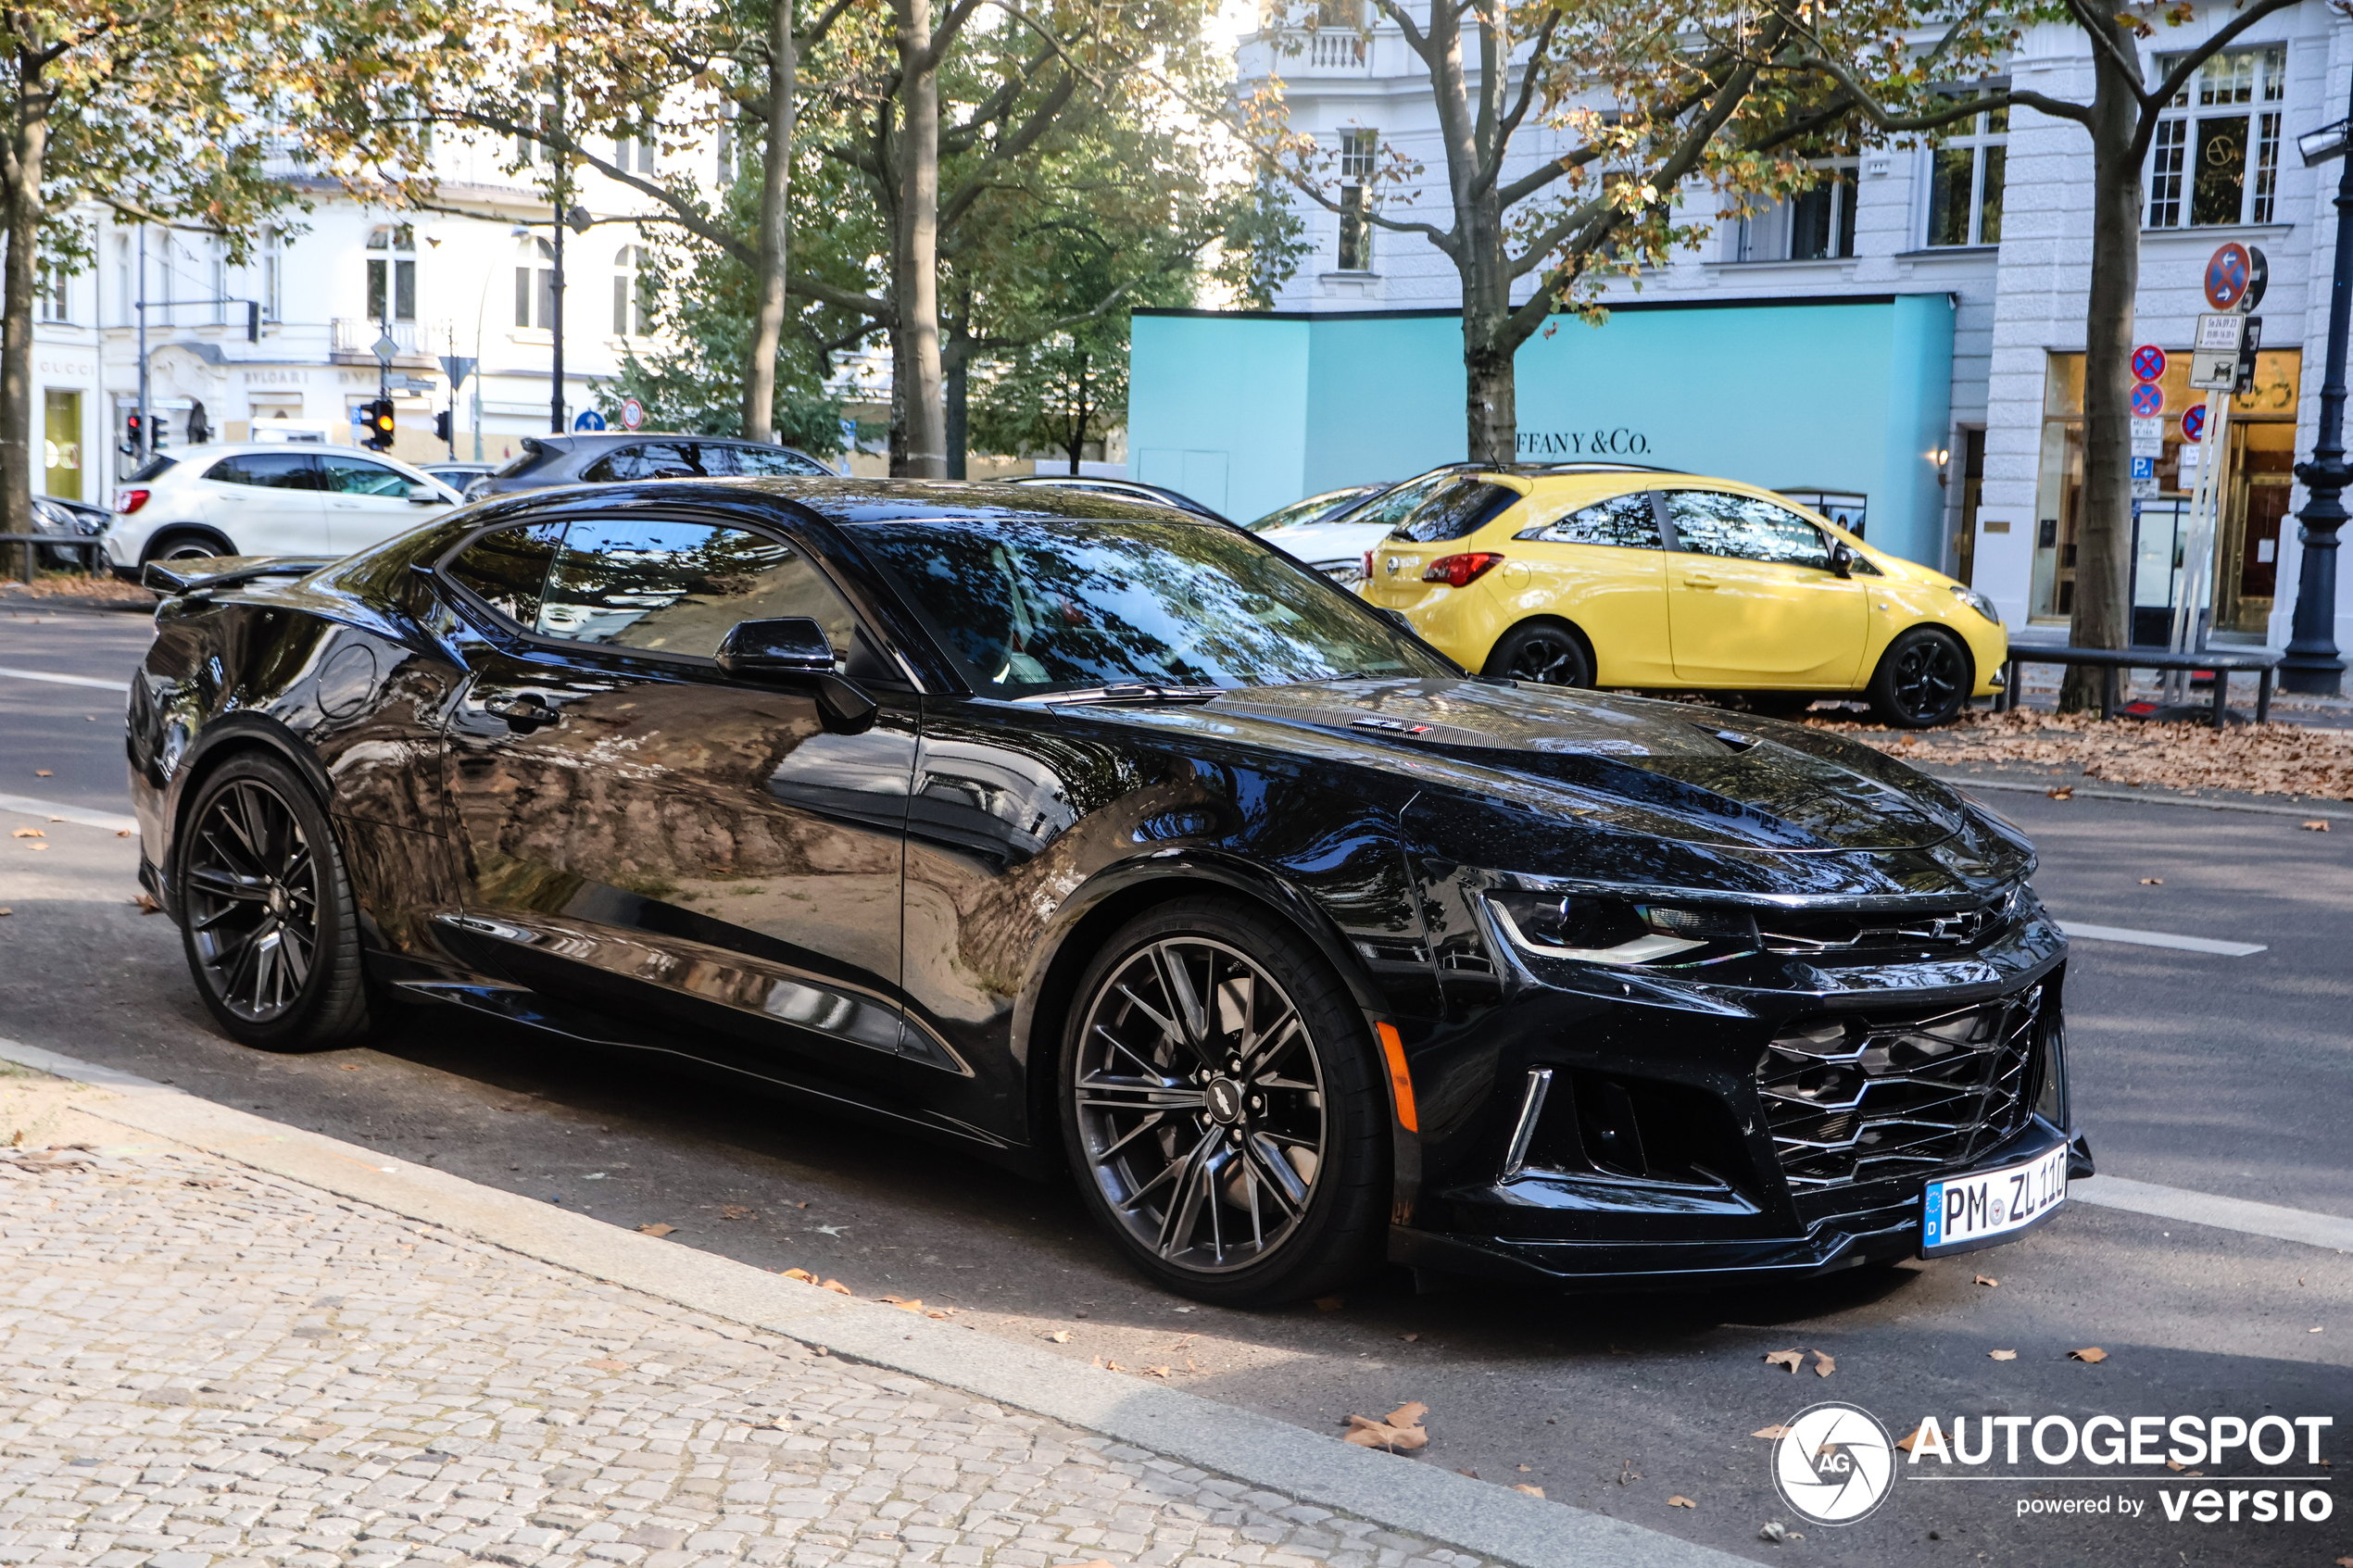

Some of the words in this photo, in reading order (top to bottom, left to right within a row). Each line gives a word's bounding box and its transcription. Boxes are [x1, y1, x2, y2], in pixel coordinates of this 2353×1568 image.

[40, 361, 94, 376] GUCCI
[627, 408, 637, 421] 30
[1516, 433, 1585, 454] FFANY
[1945, 1182, 1987, 1236] PM
[1927, 1221, 1937, 1236] D
